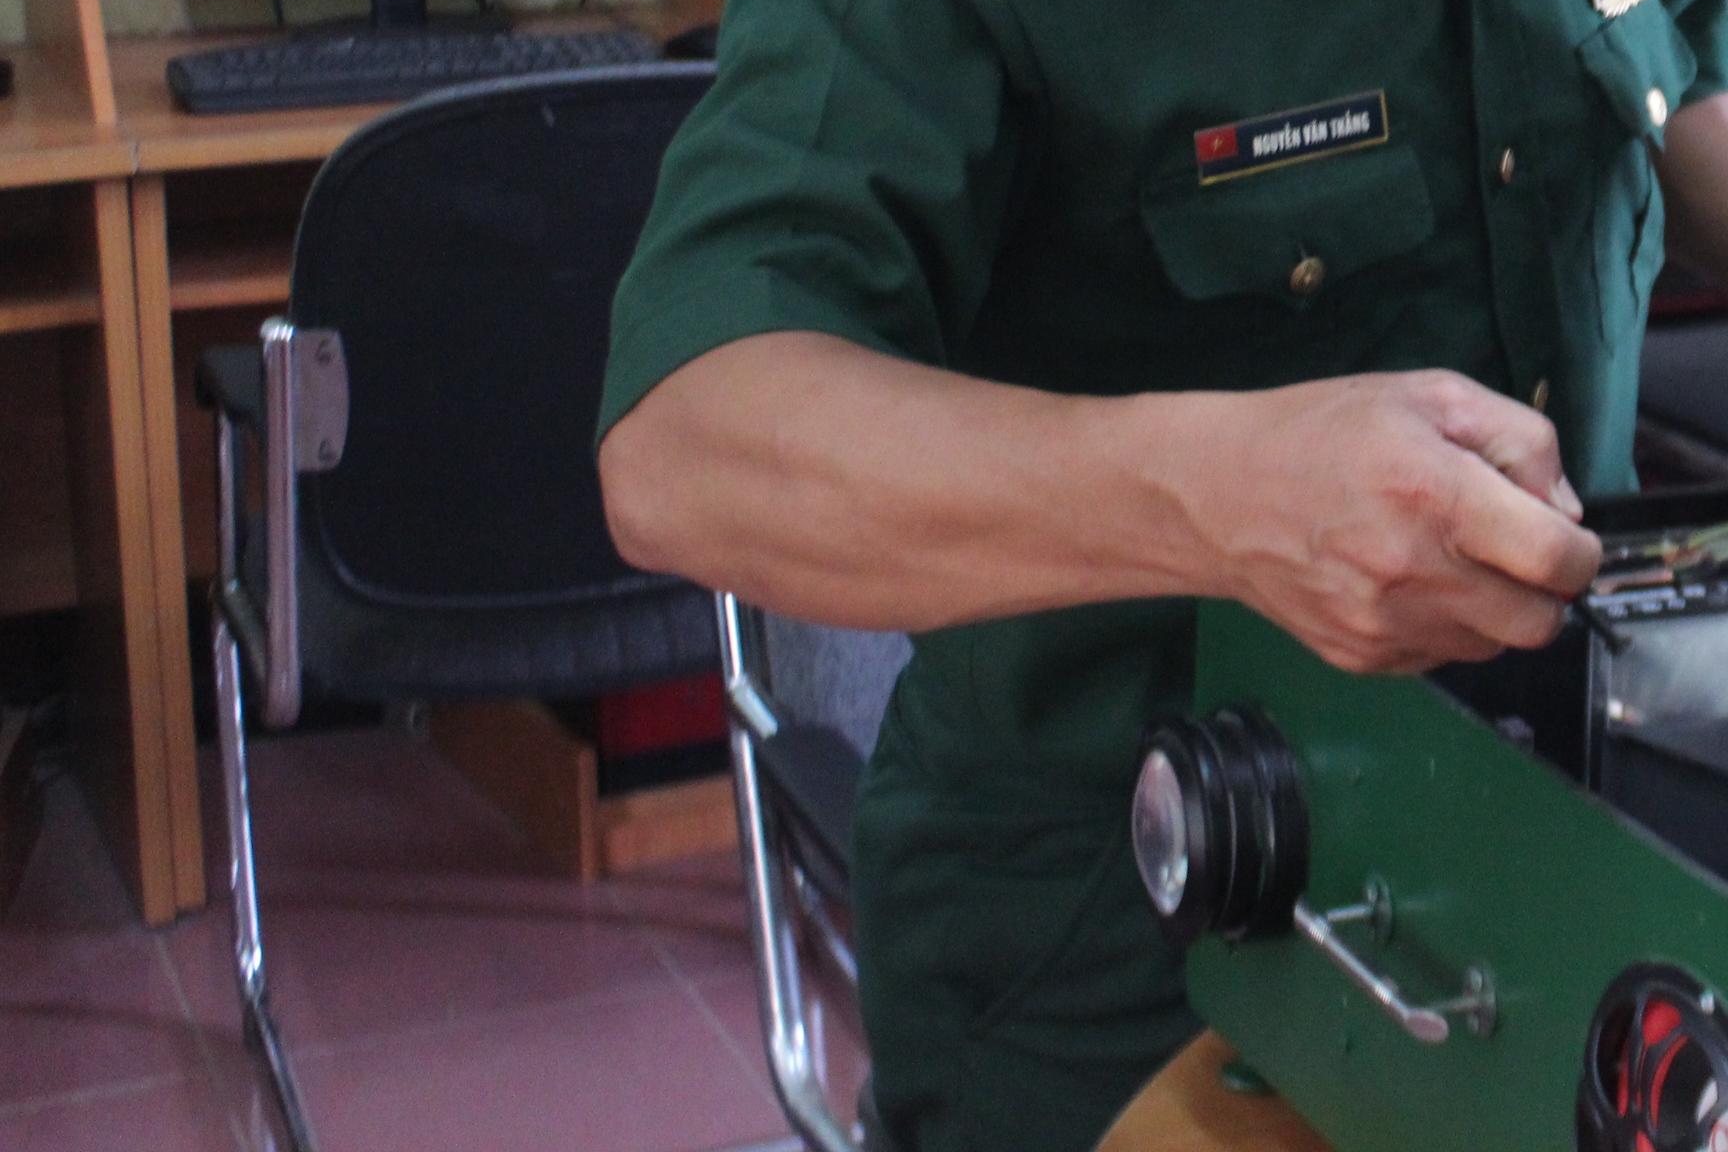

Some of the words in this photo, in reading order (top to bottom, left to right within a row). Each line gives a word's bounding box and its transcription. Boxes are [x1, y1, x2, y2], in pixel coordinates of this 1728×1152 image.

[1252, 121, 1301, 158] NGUYỄN
[1303, 118, 1328, 146] VĂN
[1329, 108, 1371, 140] THẮNG
